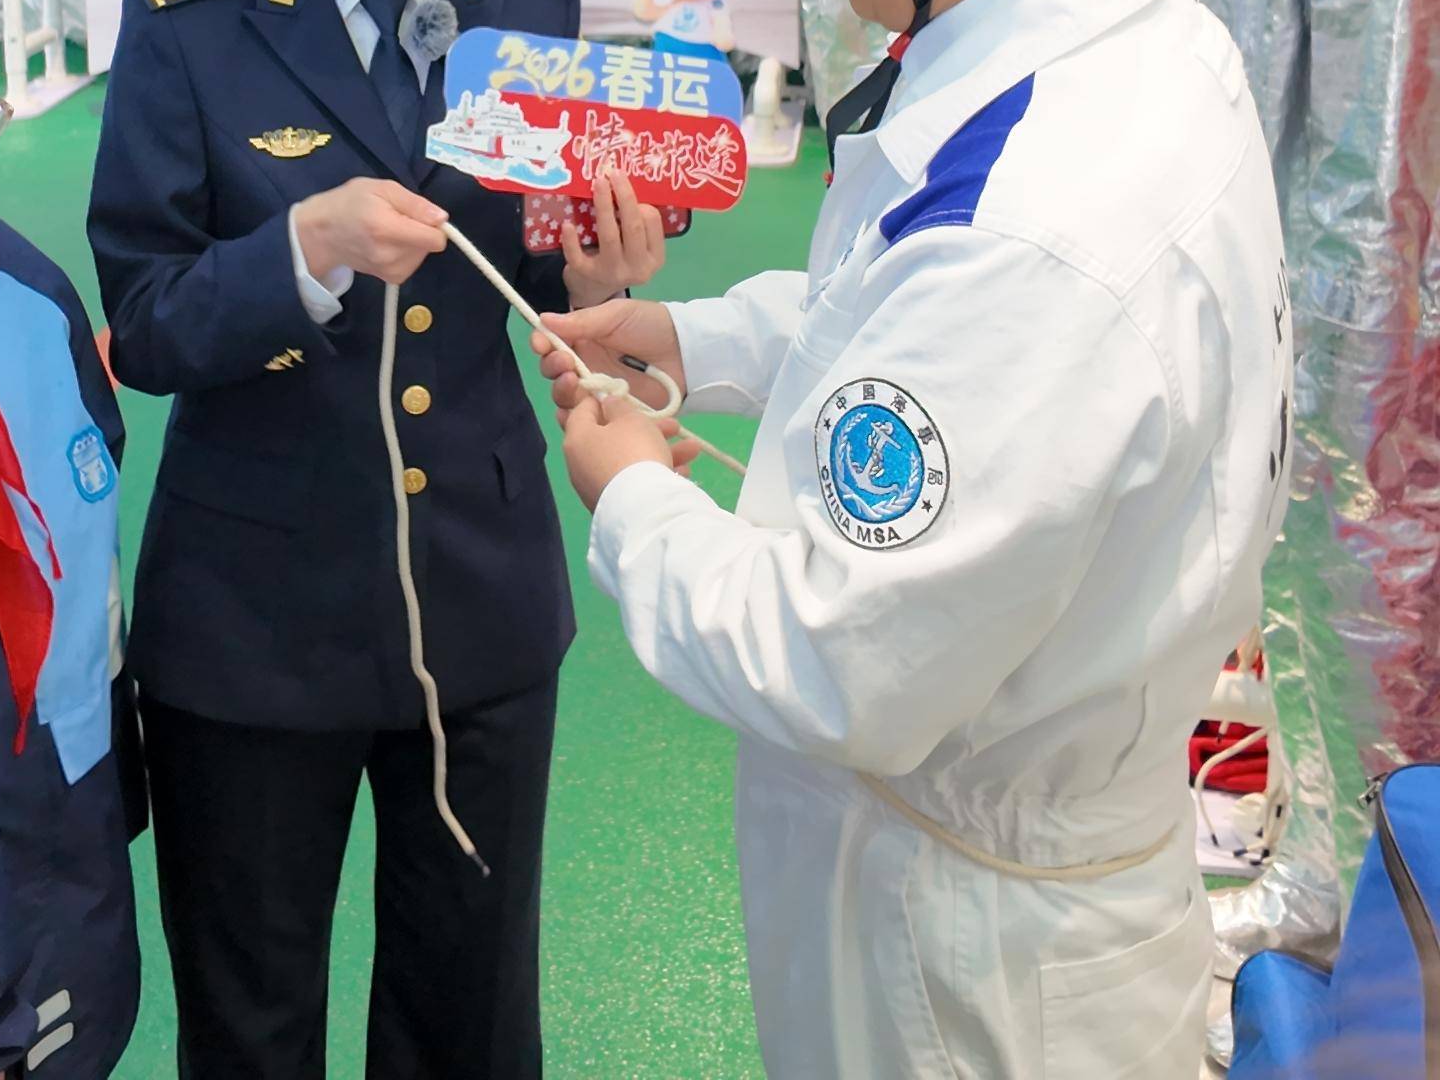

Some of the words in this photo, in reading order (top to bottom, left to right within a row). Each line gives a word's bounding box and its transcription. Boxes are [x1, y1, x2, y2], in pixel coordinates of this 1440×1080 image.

[490, 35, 594, 100] 2026
[601, 46, 710, 117] 春运
[835, 384, 944, 486] 中国海事局
[821, 465, 851, 532] CHINA
[857, 526, 902, 545] MSA
